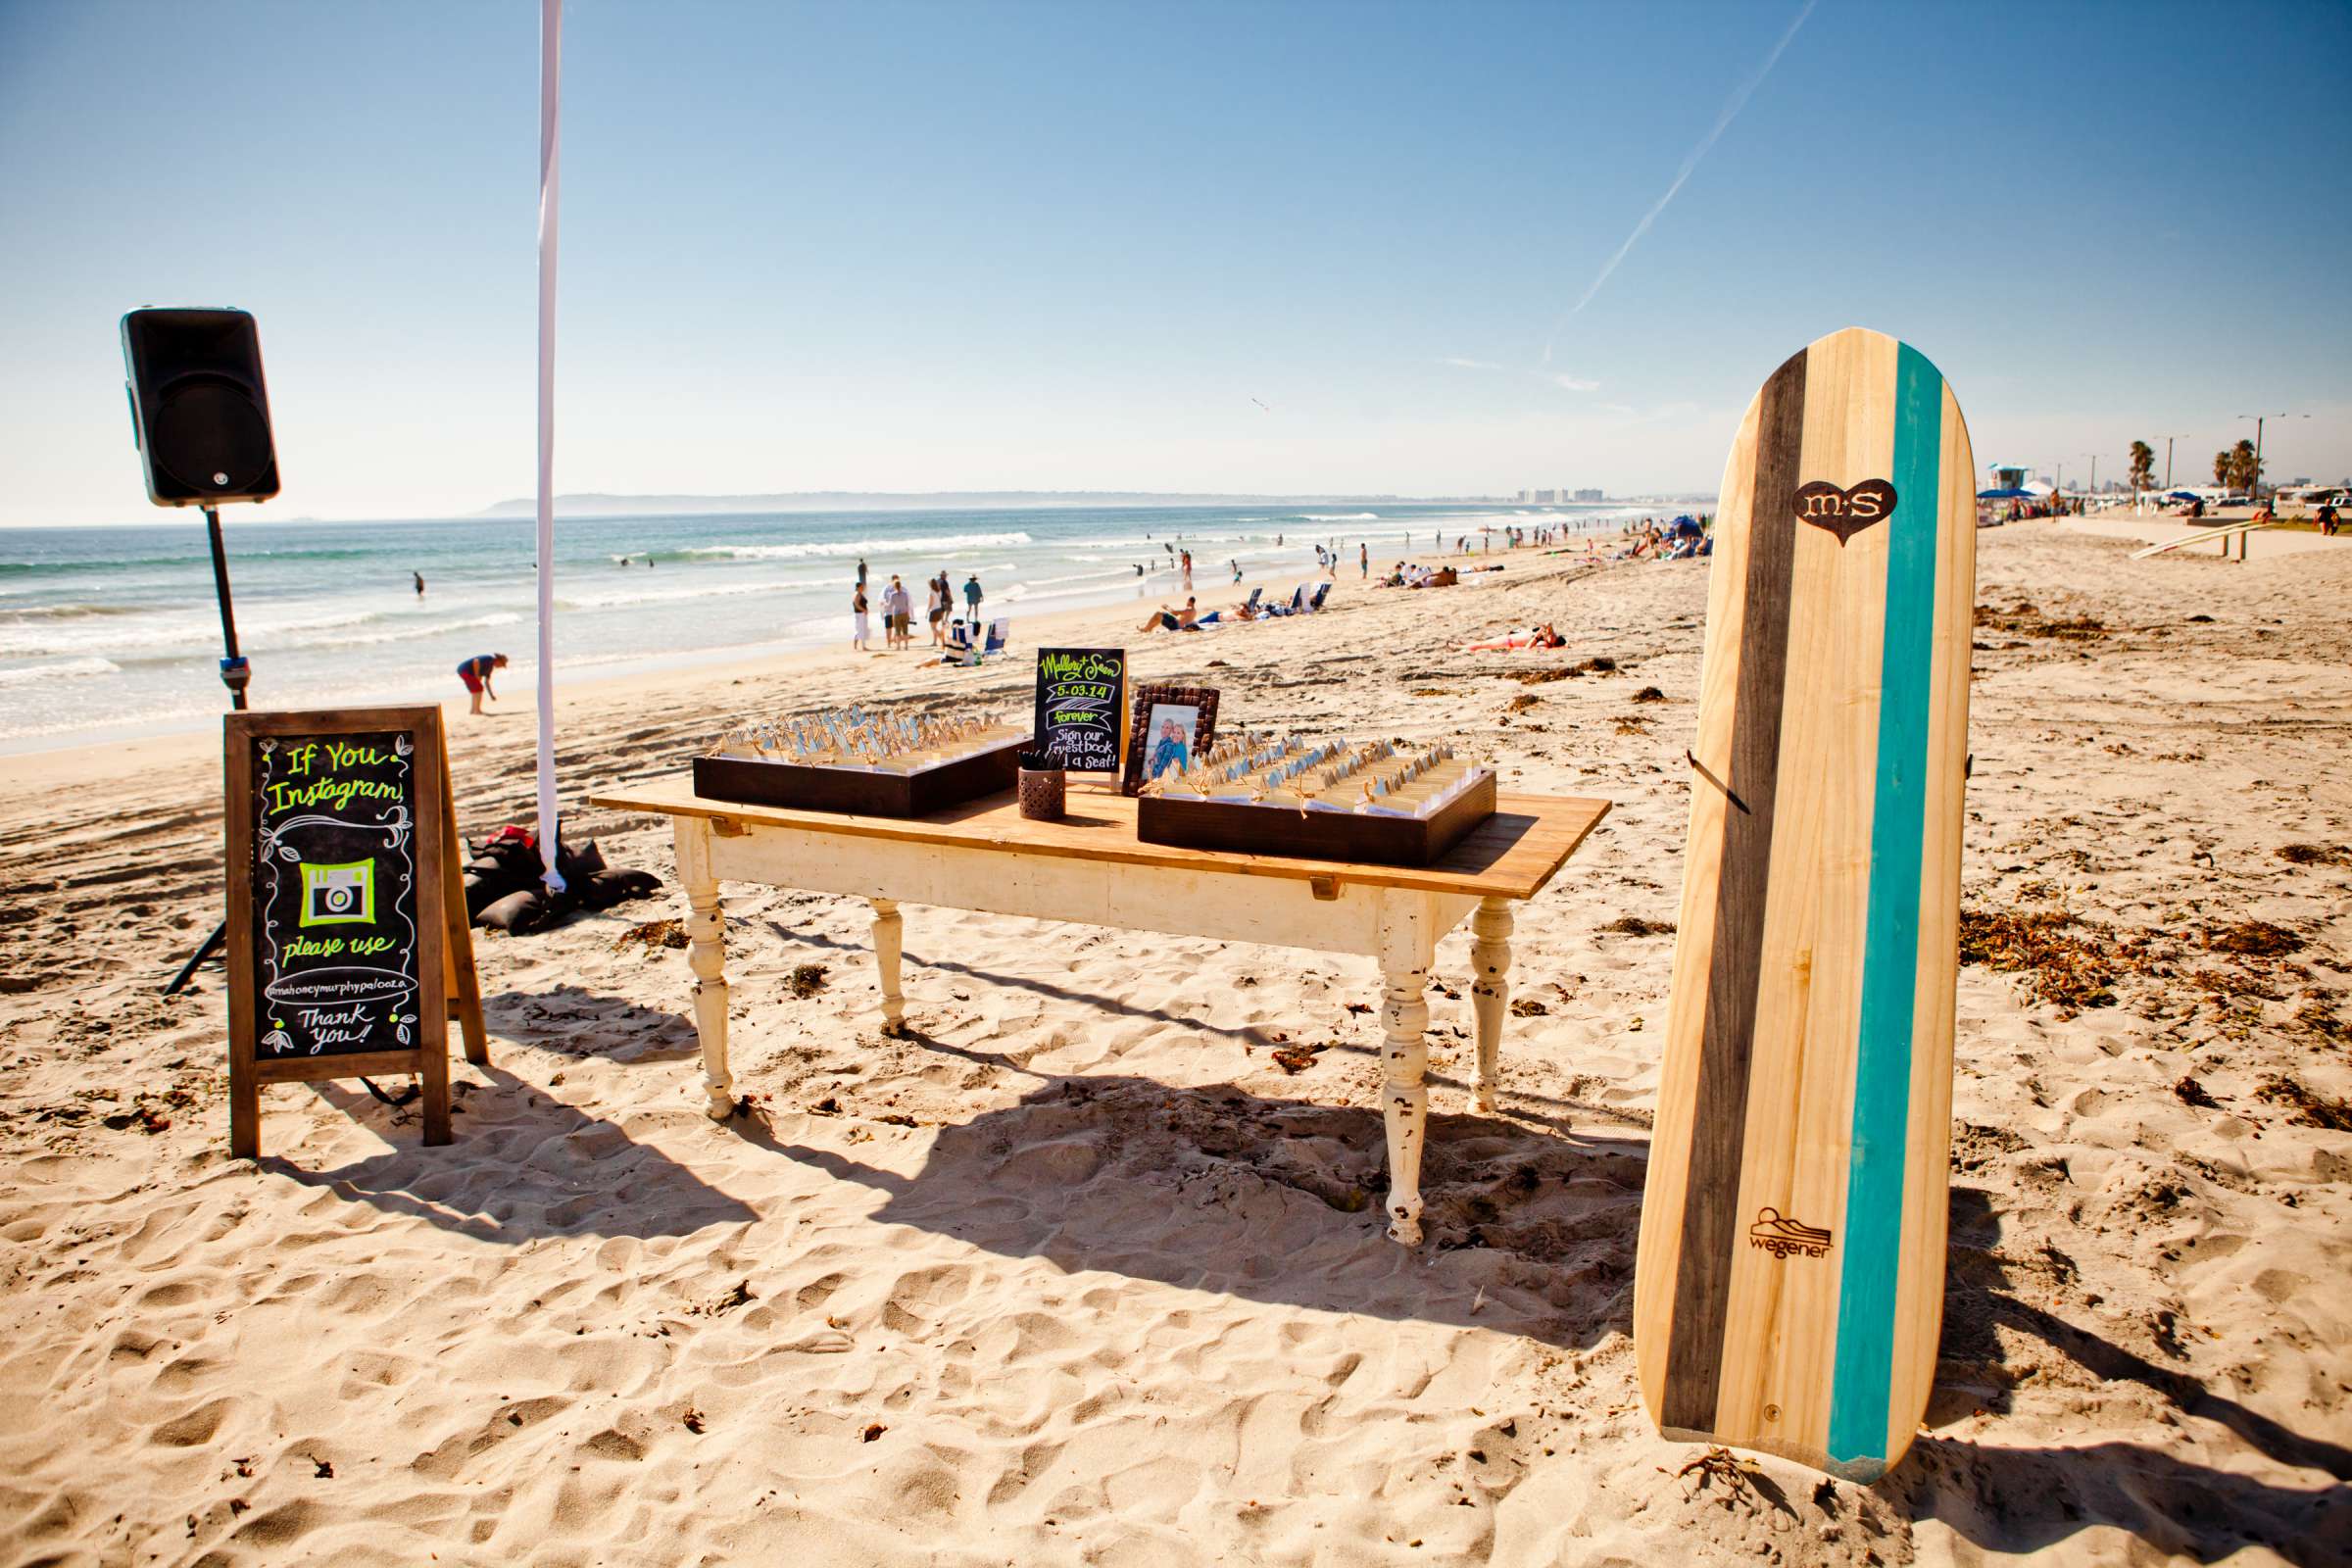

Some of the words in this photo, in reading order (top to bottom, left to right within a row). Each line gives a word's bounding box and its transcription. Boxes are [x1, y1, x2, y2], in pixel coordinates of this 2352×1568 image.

[1040, 653, 1083, 681] Mallory
[1085, 654, 1121, 680] Sean
[1054, 710, 1098, 723] forever
[1056, 728, 1081, 745] Sign
[1084, 731, 1103, 741] our
[286, 743, 318, 775] If
[325, 742, 389, 771] You
[281, 935, 345, 968] please
[349, 936, 396, 956] use
[297, 1003, 376, 1028] Thank
[309, 1024, 373, 1055] you!
[1750, 1237, 1830, 1259] wegener
